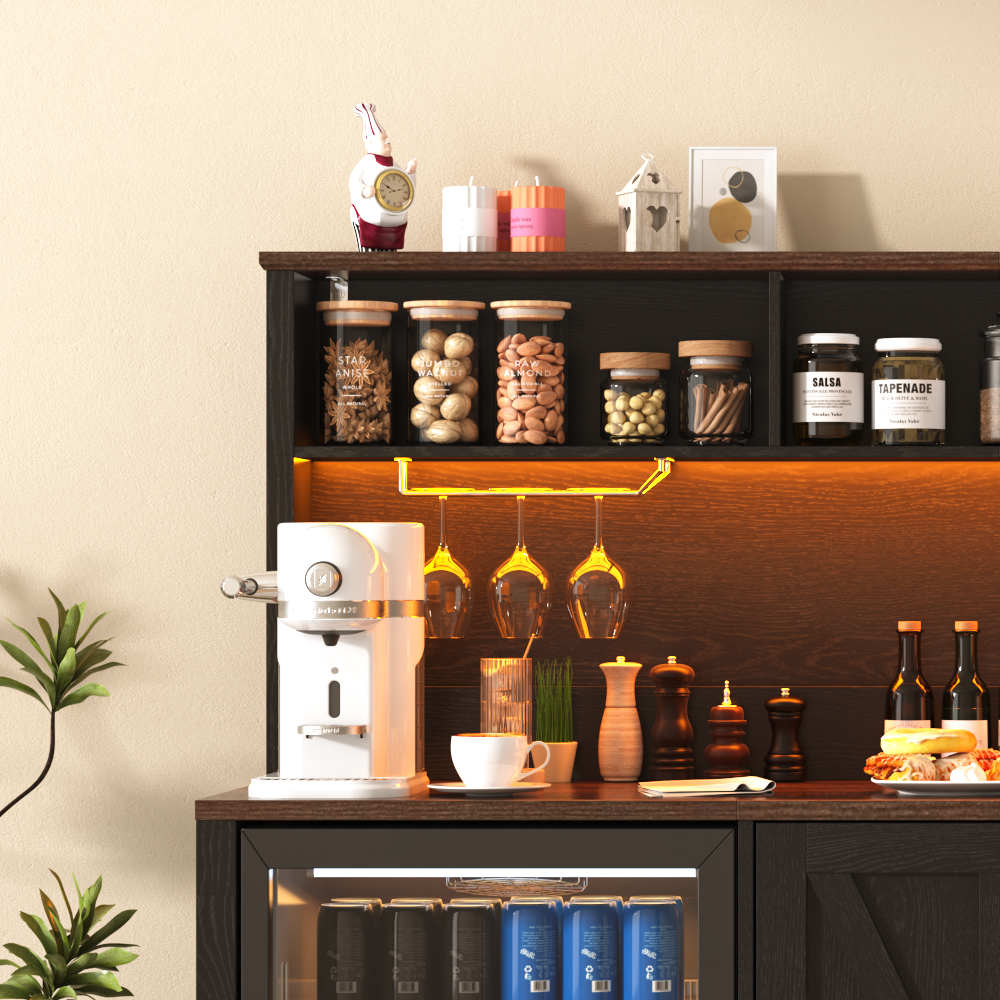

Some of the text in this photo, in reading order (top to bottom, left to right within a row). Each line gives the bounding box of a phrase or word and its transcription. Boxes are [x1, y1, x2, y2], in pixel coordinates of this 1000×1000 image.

[338, 355, 367, 365] STAR
[420, 360, 460, 368] JUMBO
[335, 368, 370, 378] ANISE
[417, 369, 464, 377] WALNUT
[503, 369, 552, 377] ALMOND
[812, 377, 842, 388] SALSA
[878, 383, 933, 394] TAPENADE
